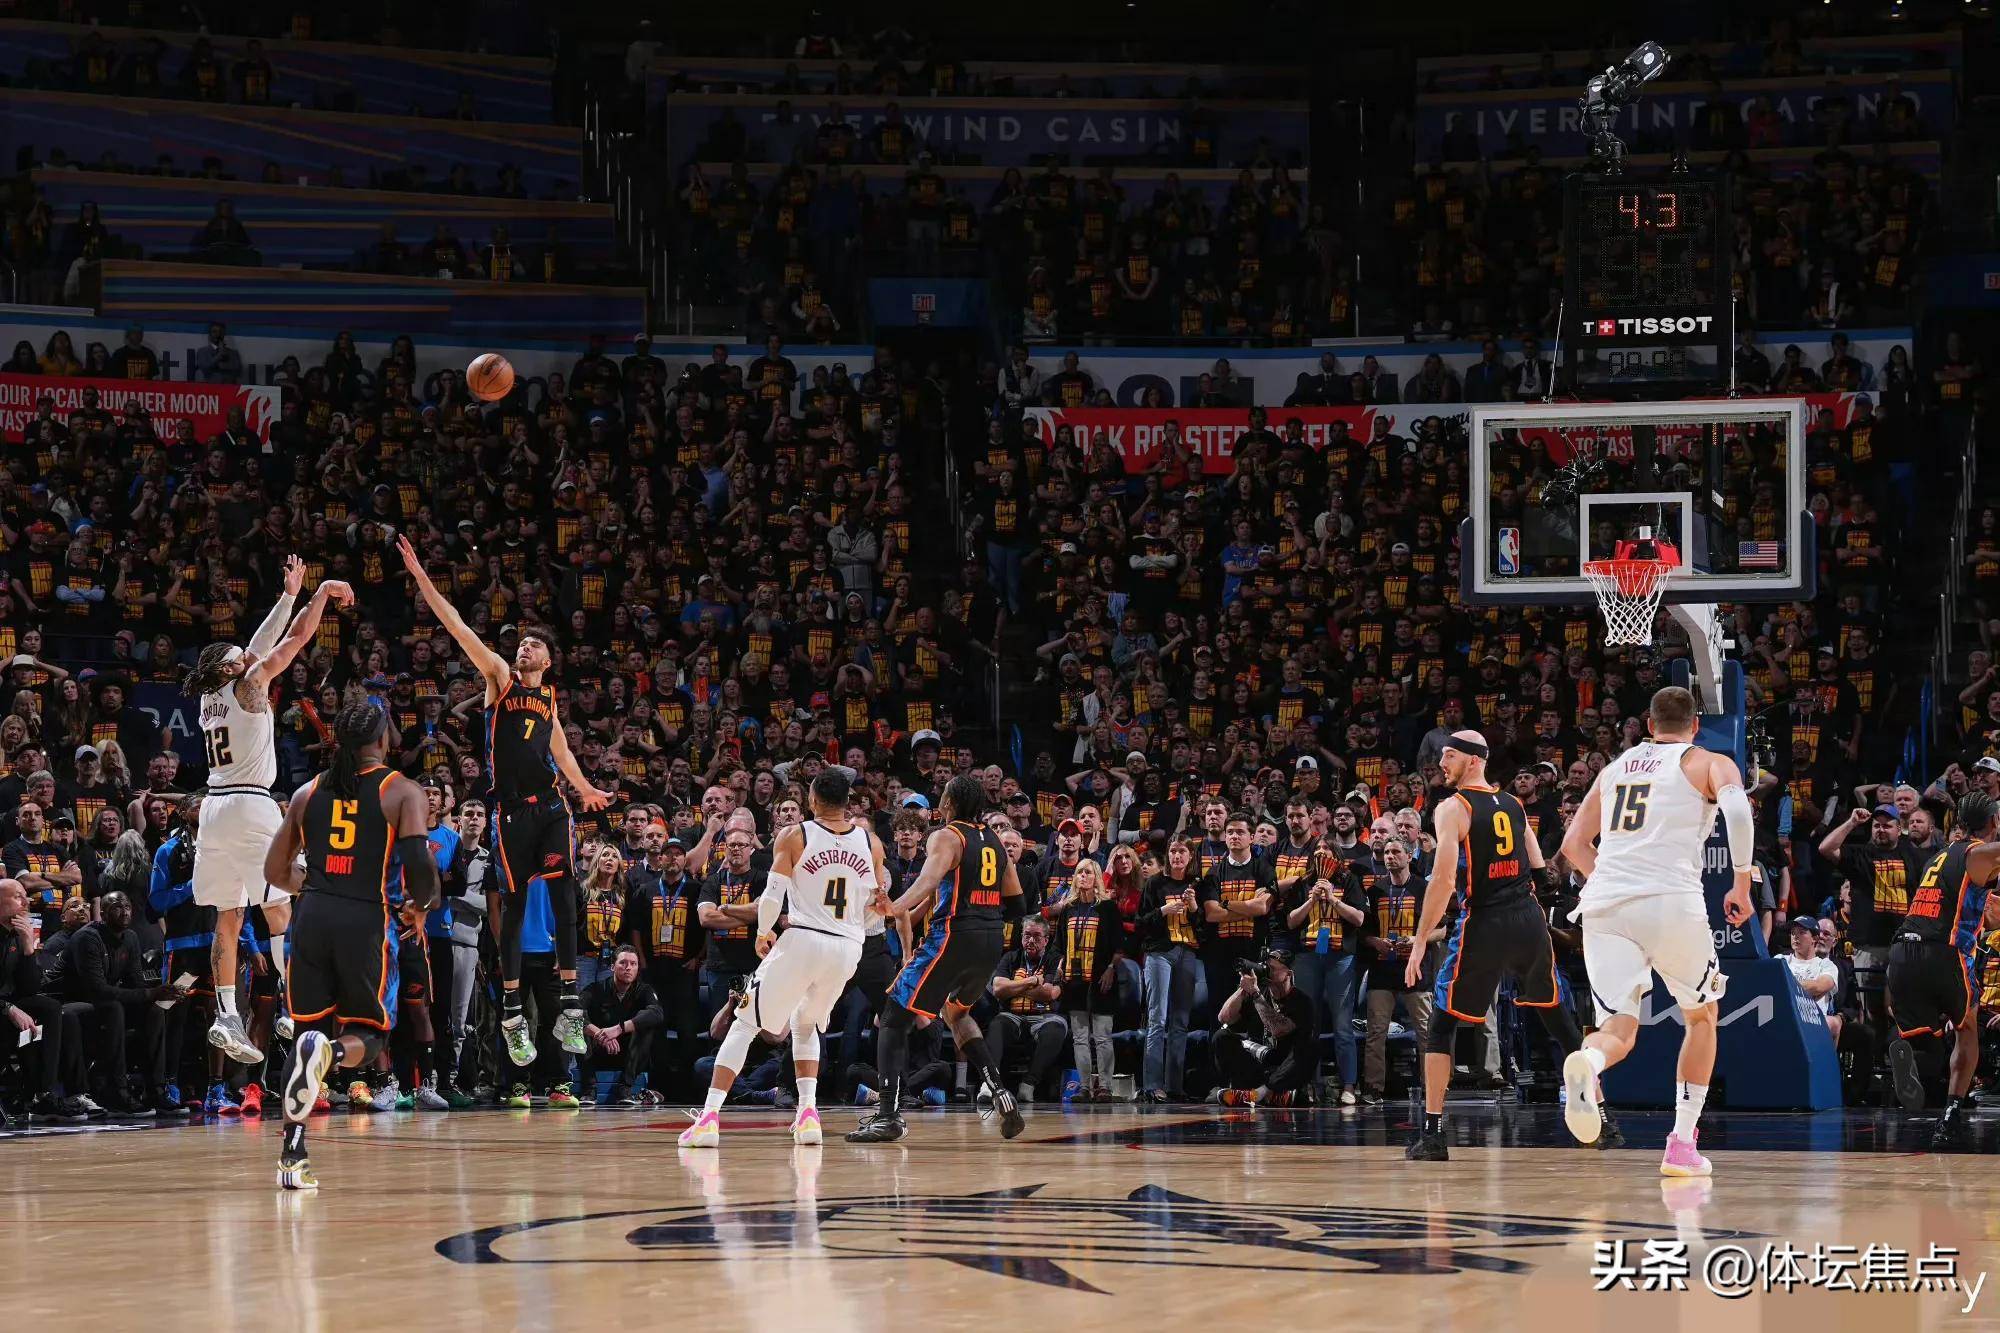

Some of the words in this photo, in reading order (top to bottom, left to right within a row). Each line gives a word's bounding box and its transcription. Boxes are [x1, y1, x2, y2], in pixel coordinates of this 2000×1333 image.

[1047, 116, 1181, 143] CASIN
[1618, 192, 1678, 230] 4.3
[1618, 316, 1712, 335] TISSOT
[170, 393, 219, 416] MOON
[1134, 424, 1250, 457] ROSTE
[505, 695, 551, 721] OKLAHOMA
[523, 718, 536, 740] 7
[1609, 782, 1652, 832] 15
[329, 799, 358, 850] 5
[1492, 810, 1514, 857] 9
[326, 854, 355, 875] DORT
[802, 850, 871, 879] WESTBROOK
[980, 846, 997, 887] 8
[1919, 851, 1948, 887] 2
[823, 877, 848, 919] 4
[1712, 925, 1744, 950] gle
